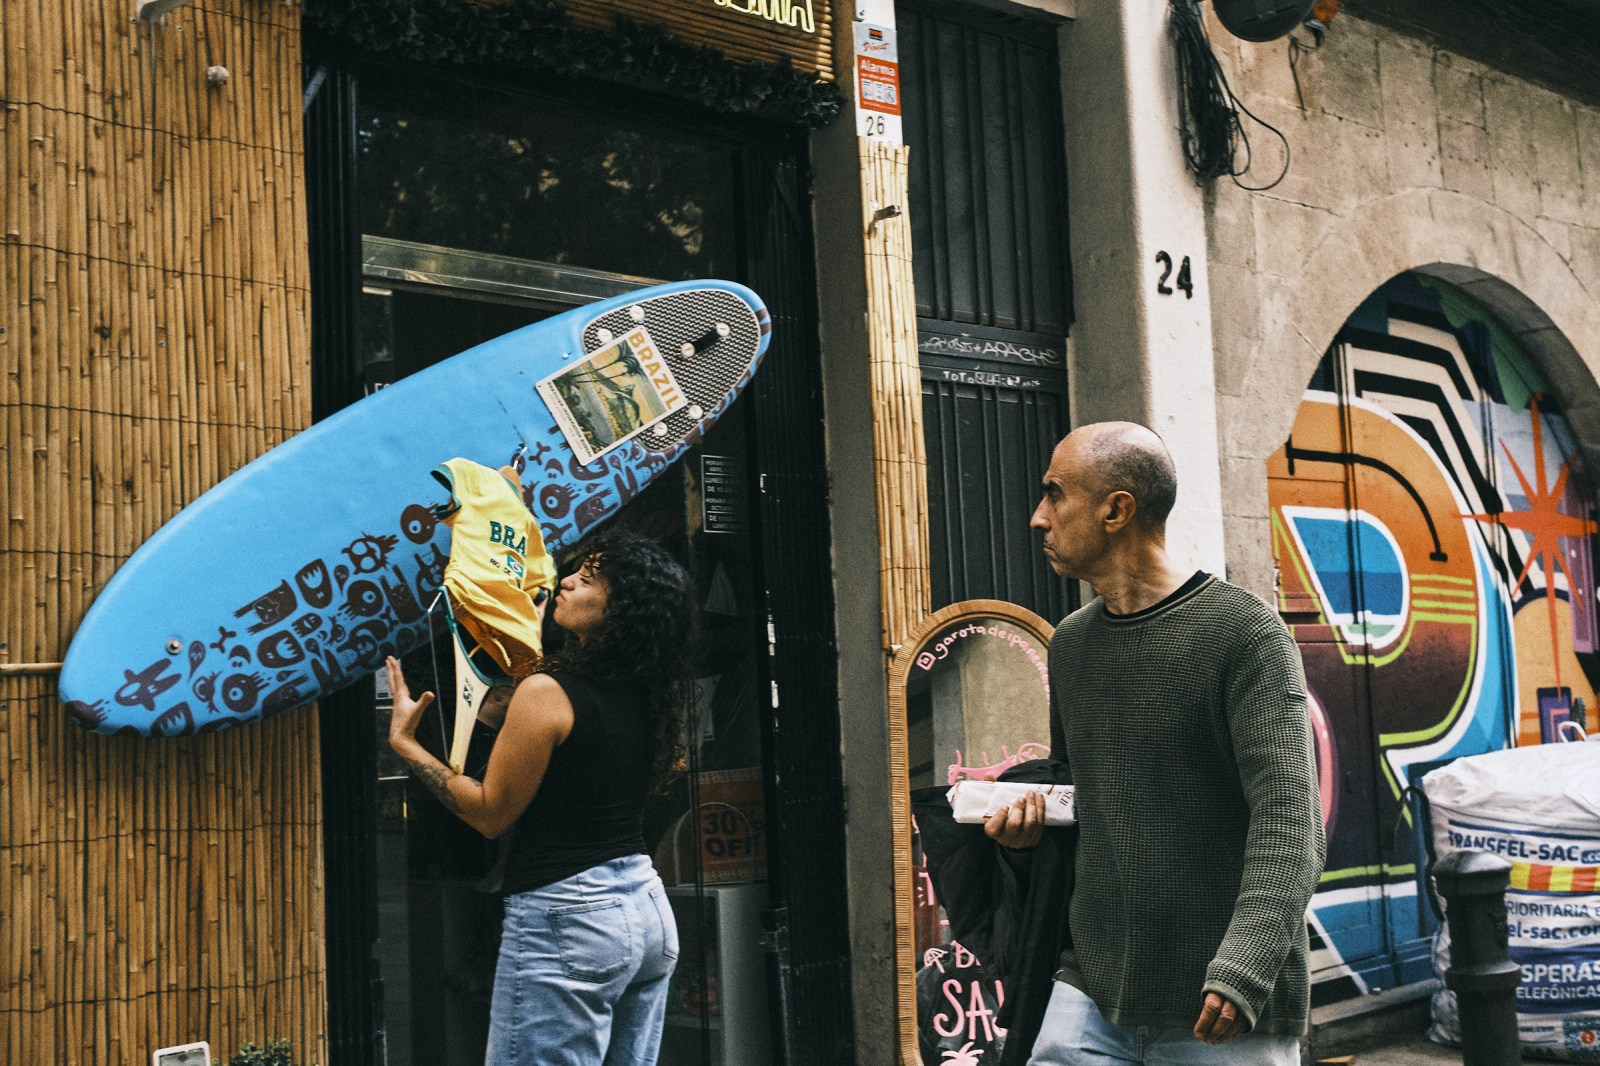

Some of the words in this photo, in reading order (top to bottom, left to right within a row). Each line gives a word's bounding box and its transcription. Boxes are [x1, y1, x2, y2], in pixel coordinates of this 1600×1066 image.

[861, 60, 896, 76] Alarma
[866, 116, 885, 136] 26
[1156, 250, 1193, 299] 24
[628, 331, 680, 410] BRAZIL
